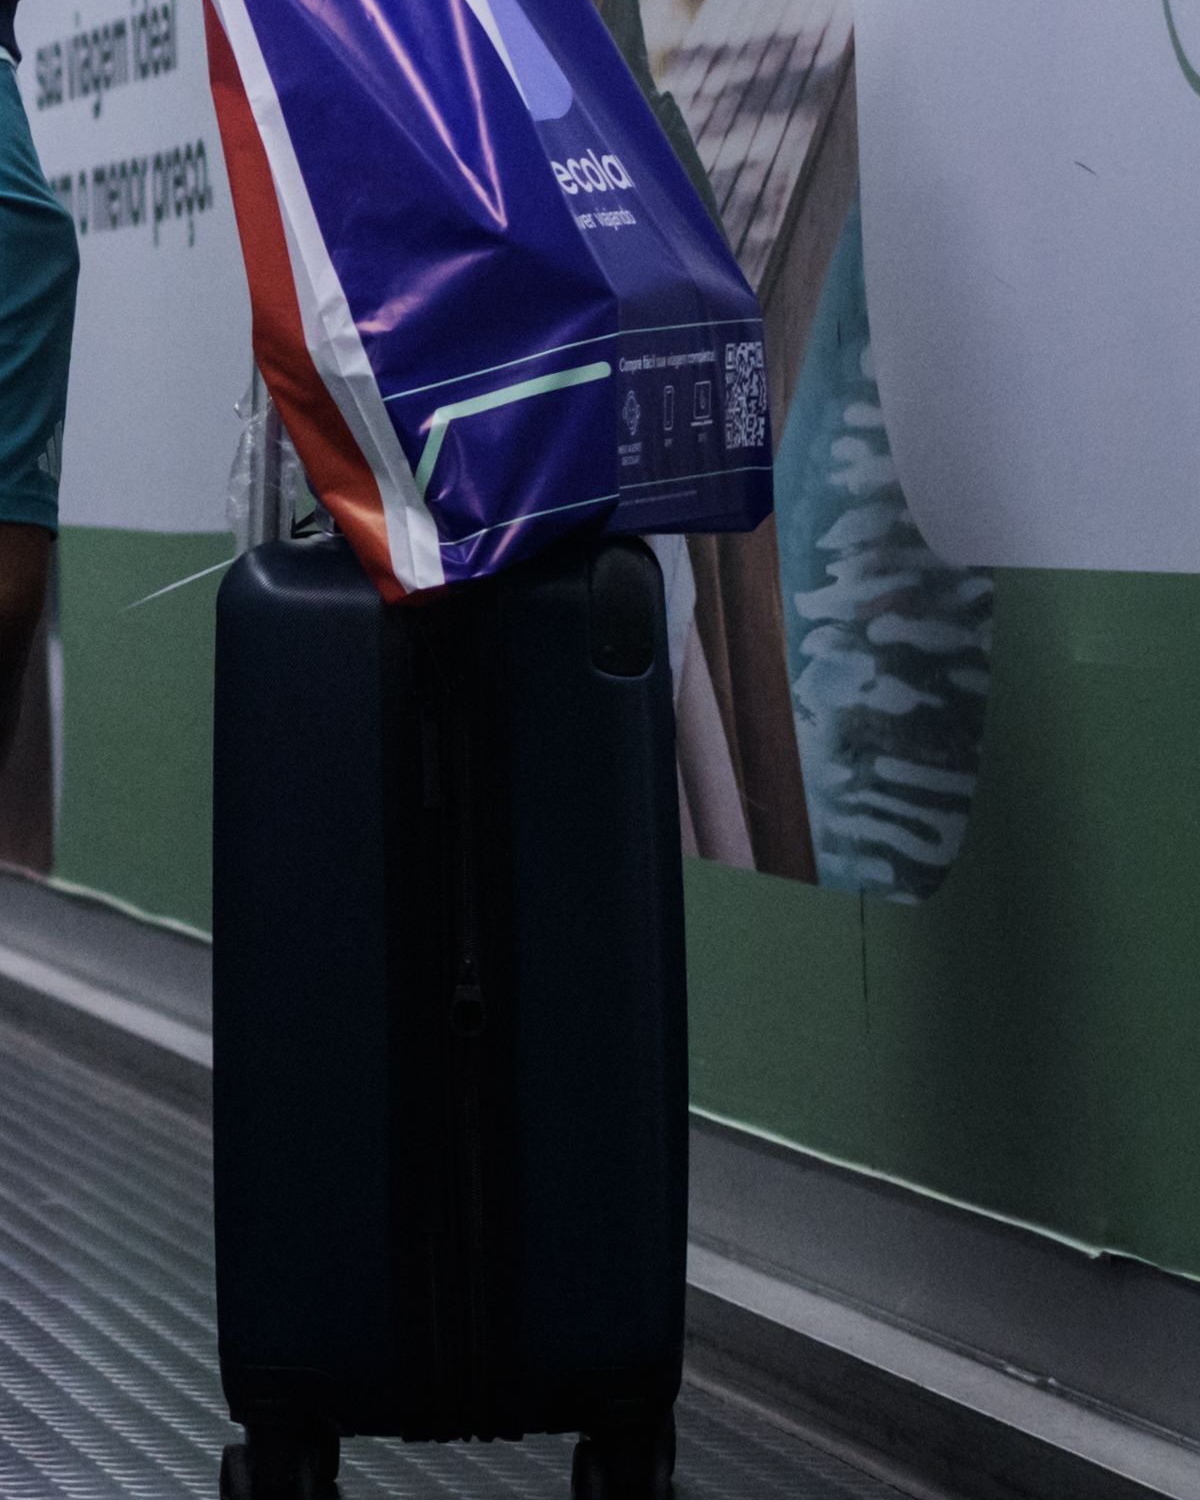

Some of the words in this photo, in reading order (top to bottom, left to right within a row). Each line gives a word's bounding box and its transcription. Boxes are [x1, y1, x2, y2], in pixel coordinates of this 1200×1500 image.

[65, 10, 128, 120] viagem
[91, 158, 148, 232] menor
[550, 148, 635, 195] ecola
